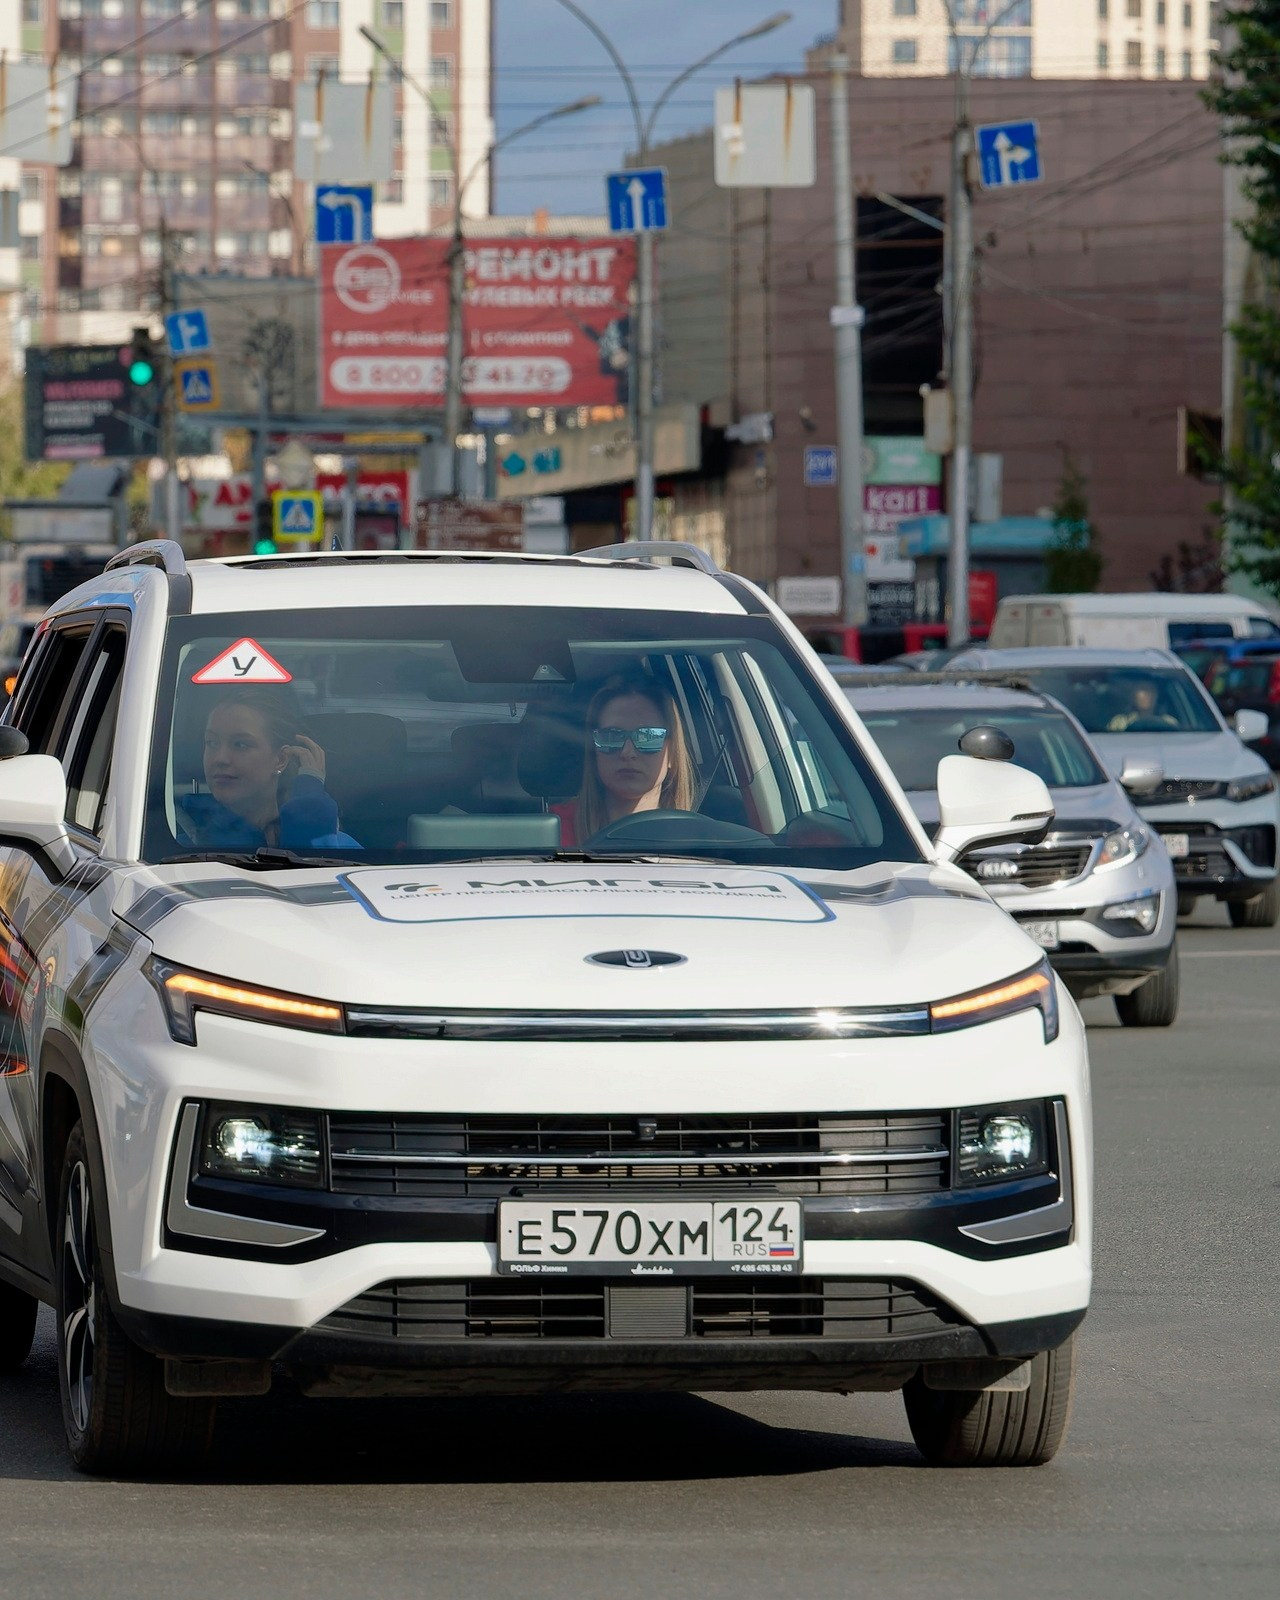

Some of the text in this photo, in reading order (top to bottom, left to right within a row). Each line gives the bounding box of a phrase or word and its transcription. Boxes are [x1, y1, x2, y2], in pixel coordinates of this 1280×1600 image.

[462, 285, 559, 308] УЛЕВЫХ
[867, 486, 928, 511] kari
[232, 656, 257, 677] У
[981, 862, 1017, 876] KIA
[467, 879, 781, 893] МИГБИ
[391, 892, 451, 900] ЦЕНТР
[680, 890, 787, 899] ВОЖДЕНИЯ
[720, 1207, 788, 1242] 124
[733, 1244, 767, 1256] RUS
[510, 1264, 540, 1272] РОЛЬФ
[541, 1264, 567, 1272] Химки
[730, 1264, 740, 1272] +7
[741, 1264, 755, 1272] 495
